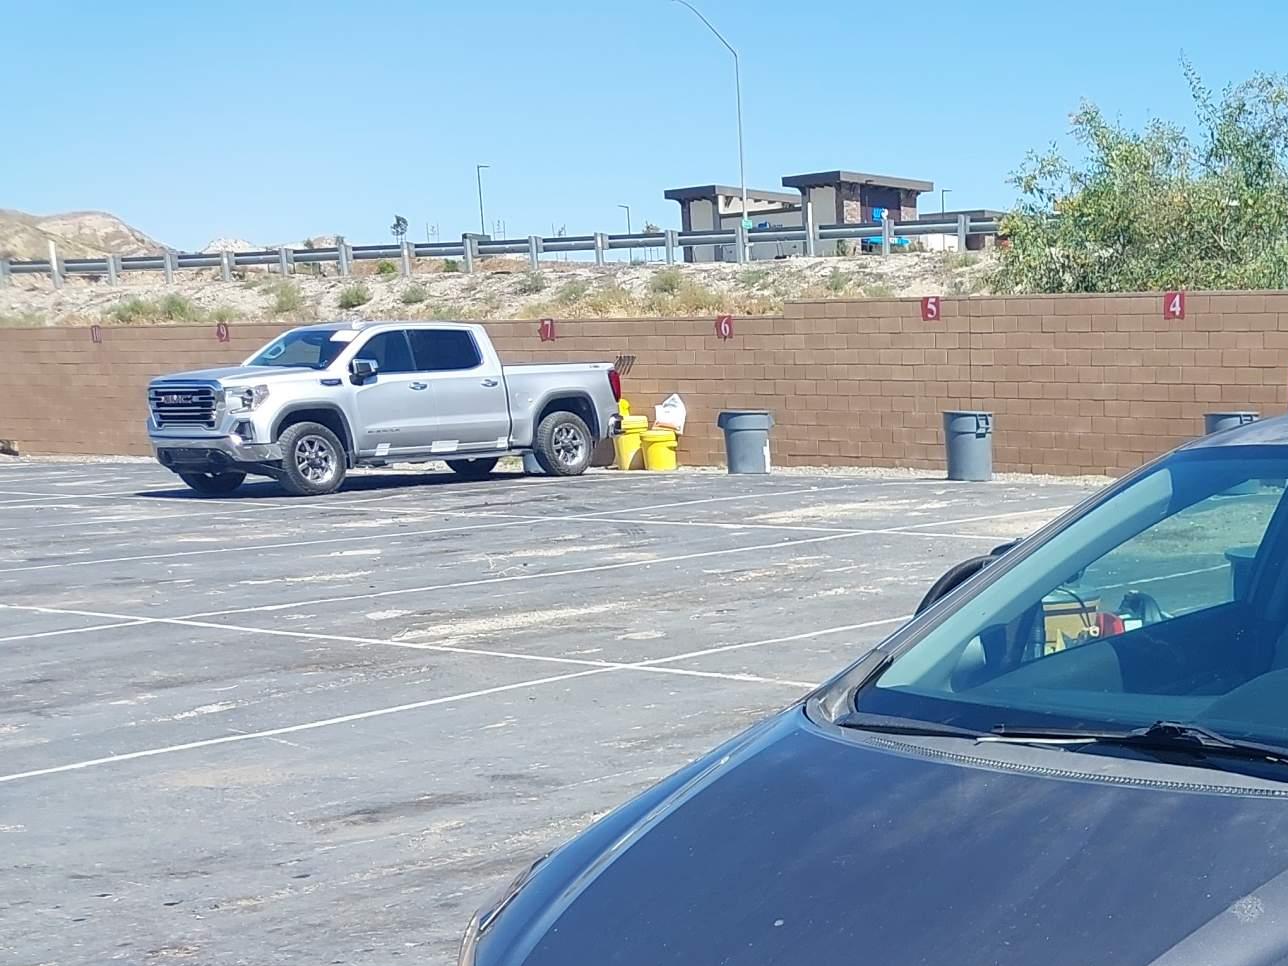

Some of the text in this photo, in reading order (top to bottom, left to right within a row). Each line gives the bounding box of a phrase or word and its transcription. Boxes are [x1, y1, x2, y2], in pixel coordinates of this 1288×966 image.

[927, 297, 937, 318] 5
[1169, 294, 1181, 316] 4
[219, 325, 227, 340] 9
[543, 320, 551, 338] 7
[721, 317, 730, 336] 6
